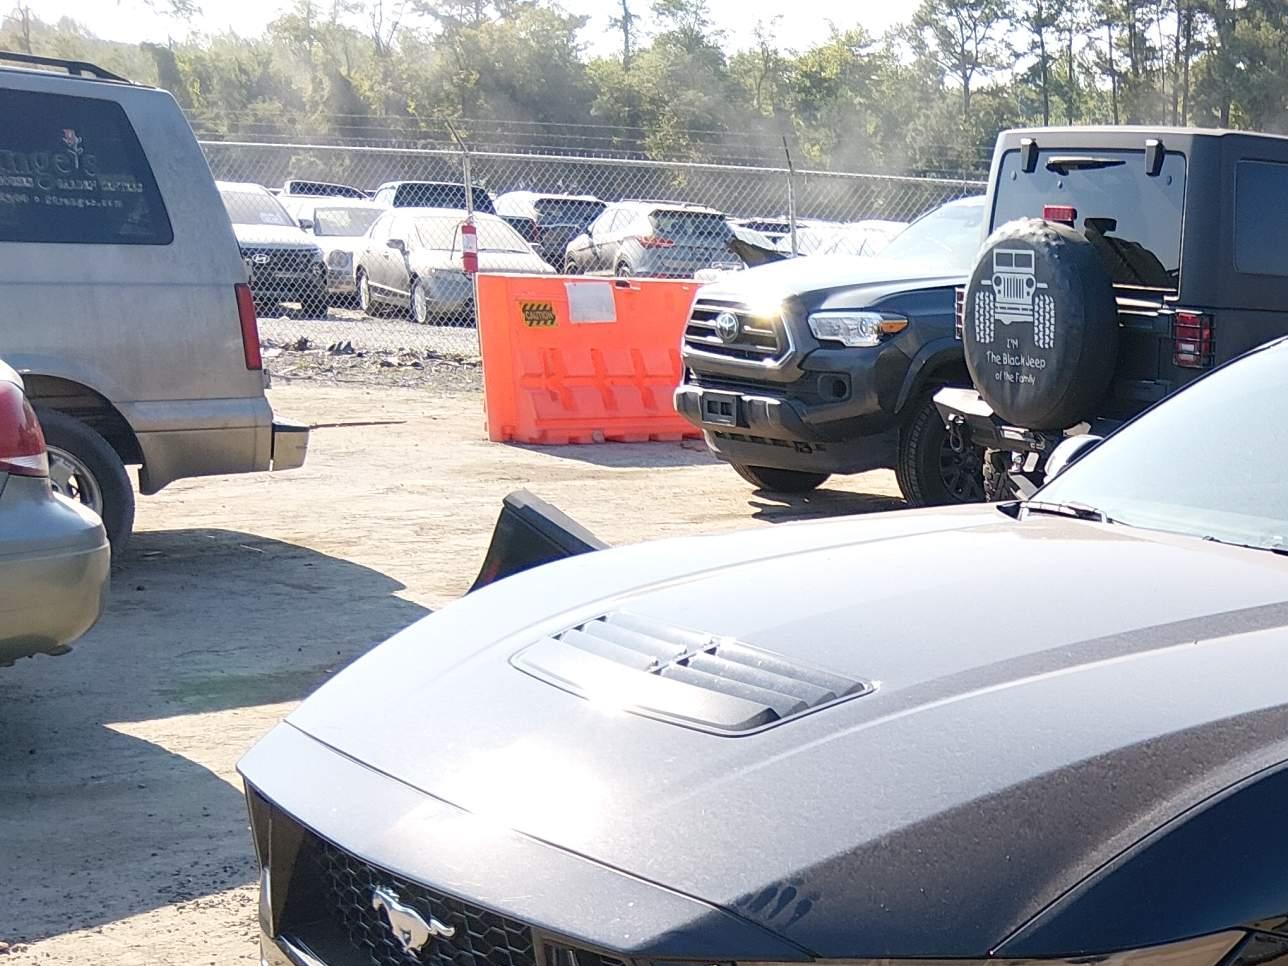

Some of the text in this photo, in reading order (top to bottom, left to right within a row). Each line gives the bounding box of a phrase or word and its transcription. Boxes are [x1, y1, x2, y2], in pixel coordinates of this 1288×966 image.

[986, 350, 1046, 370] The Black Jeep
[995, 371, 1036, 386] of the Family
